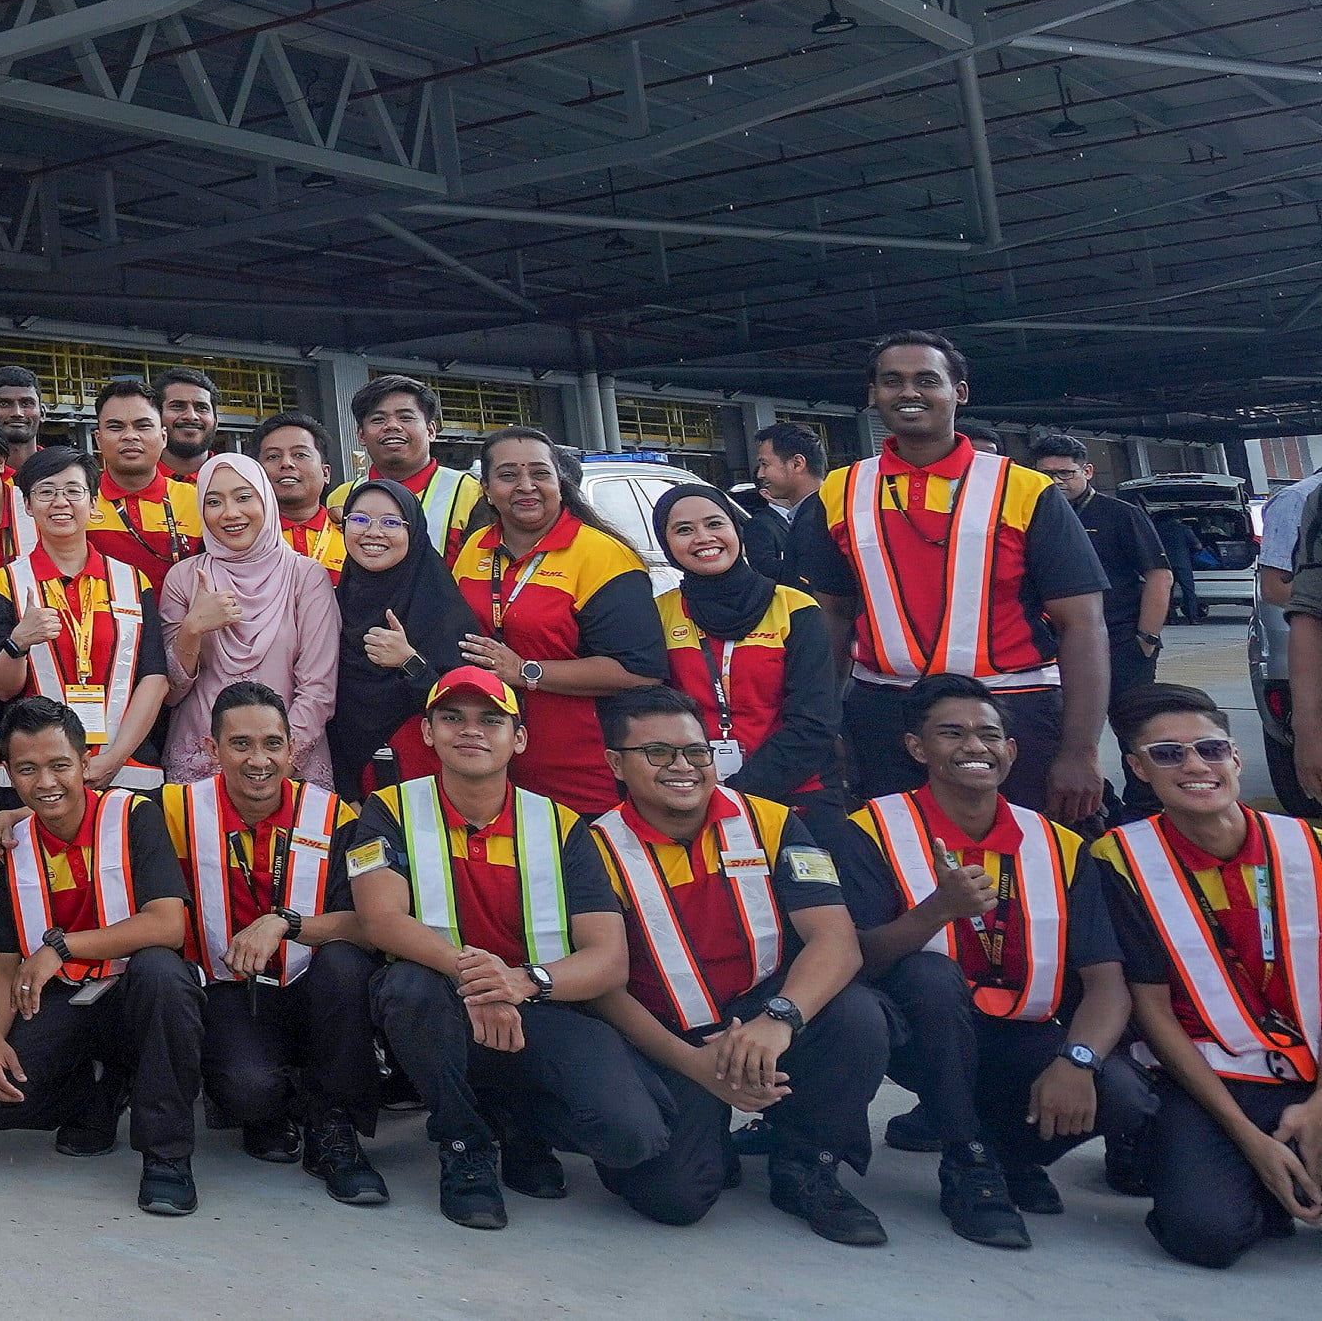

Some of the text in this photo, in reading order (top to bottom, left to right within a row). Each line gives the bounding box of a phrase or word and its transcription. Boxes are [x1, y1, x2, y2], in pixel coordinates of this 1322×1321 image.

[715, 679, 725, 705] DHL
[297, 838, 327, 850] DHL
[730, 859, 758, 867] DHL
